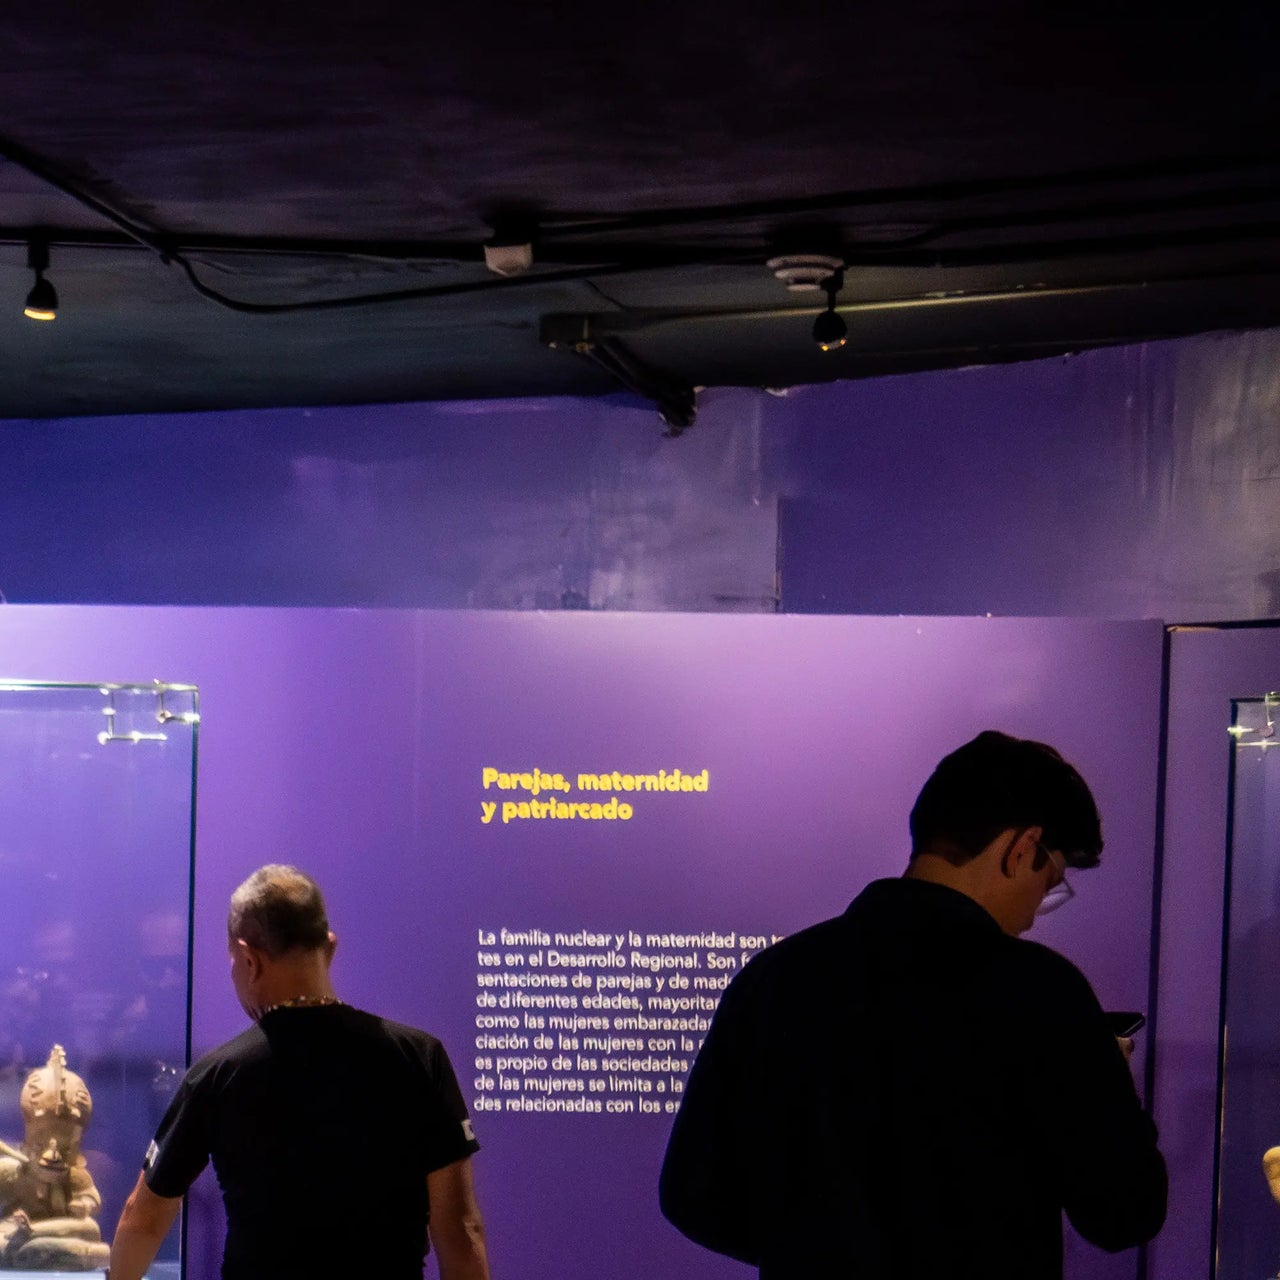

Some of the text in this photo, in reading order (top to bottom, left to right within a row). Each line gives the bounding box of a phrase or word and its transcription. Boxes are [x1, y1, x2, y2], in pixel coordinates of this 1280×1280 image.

[482, 767, 709, 796] Parejas, maternidad
[481, 797, 633, 824] y patriarcado
[478, 928, 496, 947] La
[500, 928, 551, 947] familia
[555, 929, 612, 948] nuclear
[615, 933, 625, 953] y
[628, 930, 642, 949] la
[646, 930, 736, 949] maternidad
[739, 934, 767, 950] son
[477, 950, 501, 968] tes
[505, 953, 524, 968] en
[528, 949, 543, 968] el
[547, 950, 627, 969] Desarrollo
[630, 951, 702, 974] Regional.
[706, 951, 736, 970] Son
[476, 970, 730, 995] sentaciones de parejas y de mad
[475, 990, 720, 1016] de diferentes edades, mayoritar
[475, 1012, 712, 1036] como las mujeres embarazada
[475, 1032, 529, 1051] ciación
[533, 1032, 554, 1051] de
[559, 1033, 579, 1052] las
[583, 1034, 644, 1056] mujeres
[648, 1037, 676, 1052] con
[681, 1033, 694, 1052] la
[474, 1056, 493, 1072] es
[496, 1053, 548, 1076] propio
[551, 1053, 572, 1072] de
[577, 1053, 598, 1072] las
[601, 1053, 689, 1072] sociedades
[474, 1073, 683, 1097] de las mujeres se limita a la
[473, 1094, 502, 1113] des
[506, 1094, 602, 1113] relacionadas
[606, 1098, 634, 1113] con
[639, 1095, 661, 1114] los
